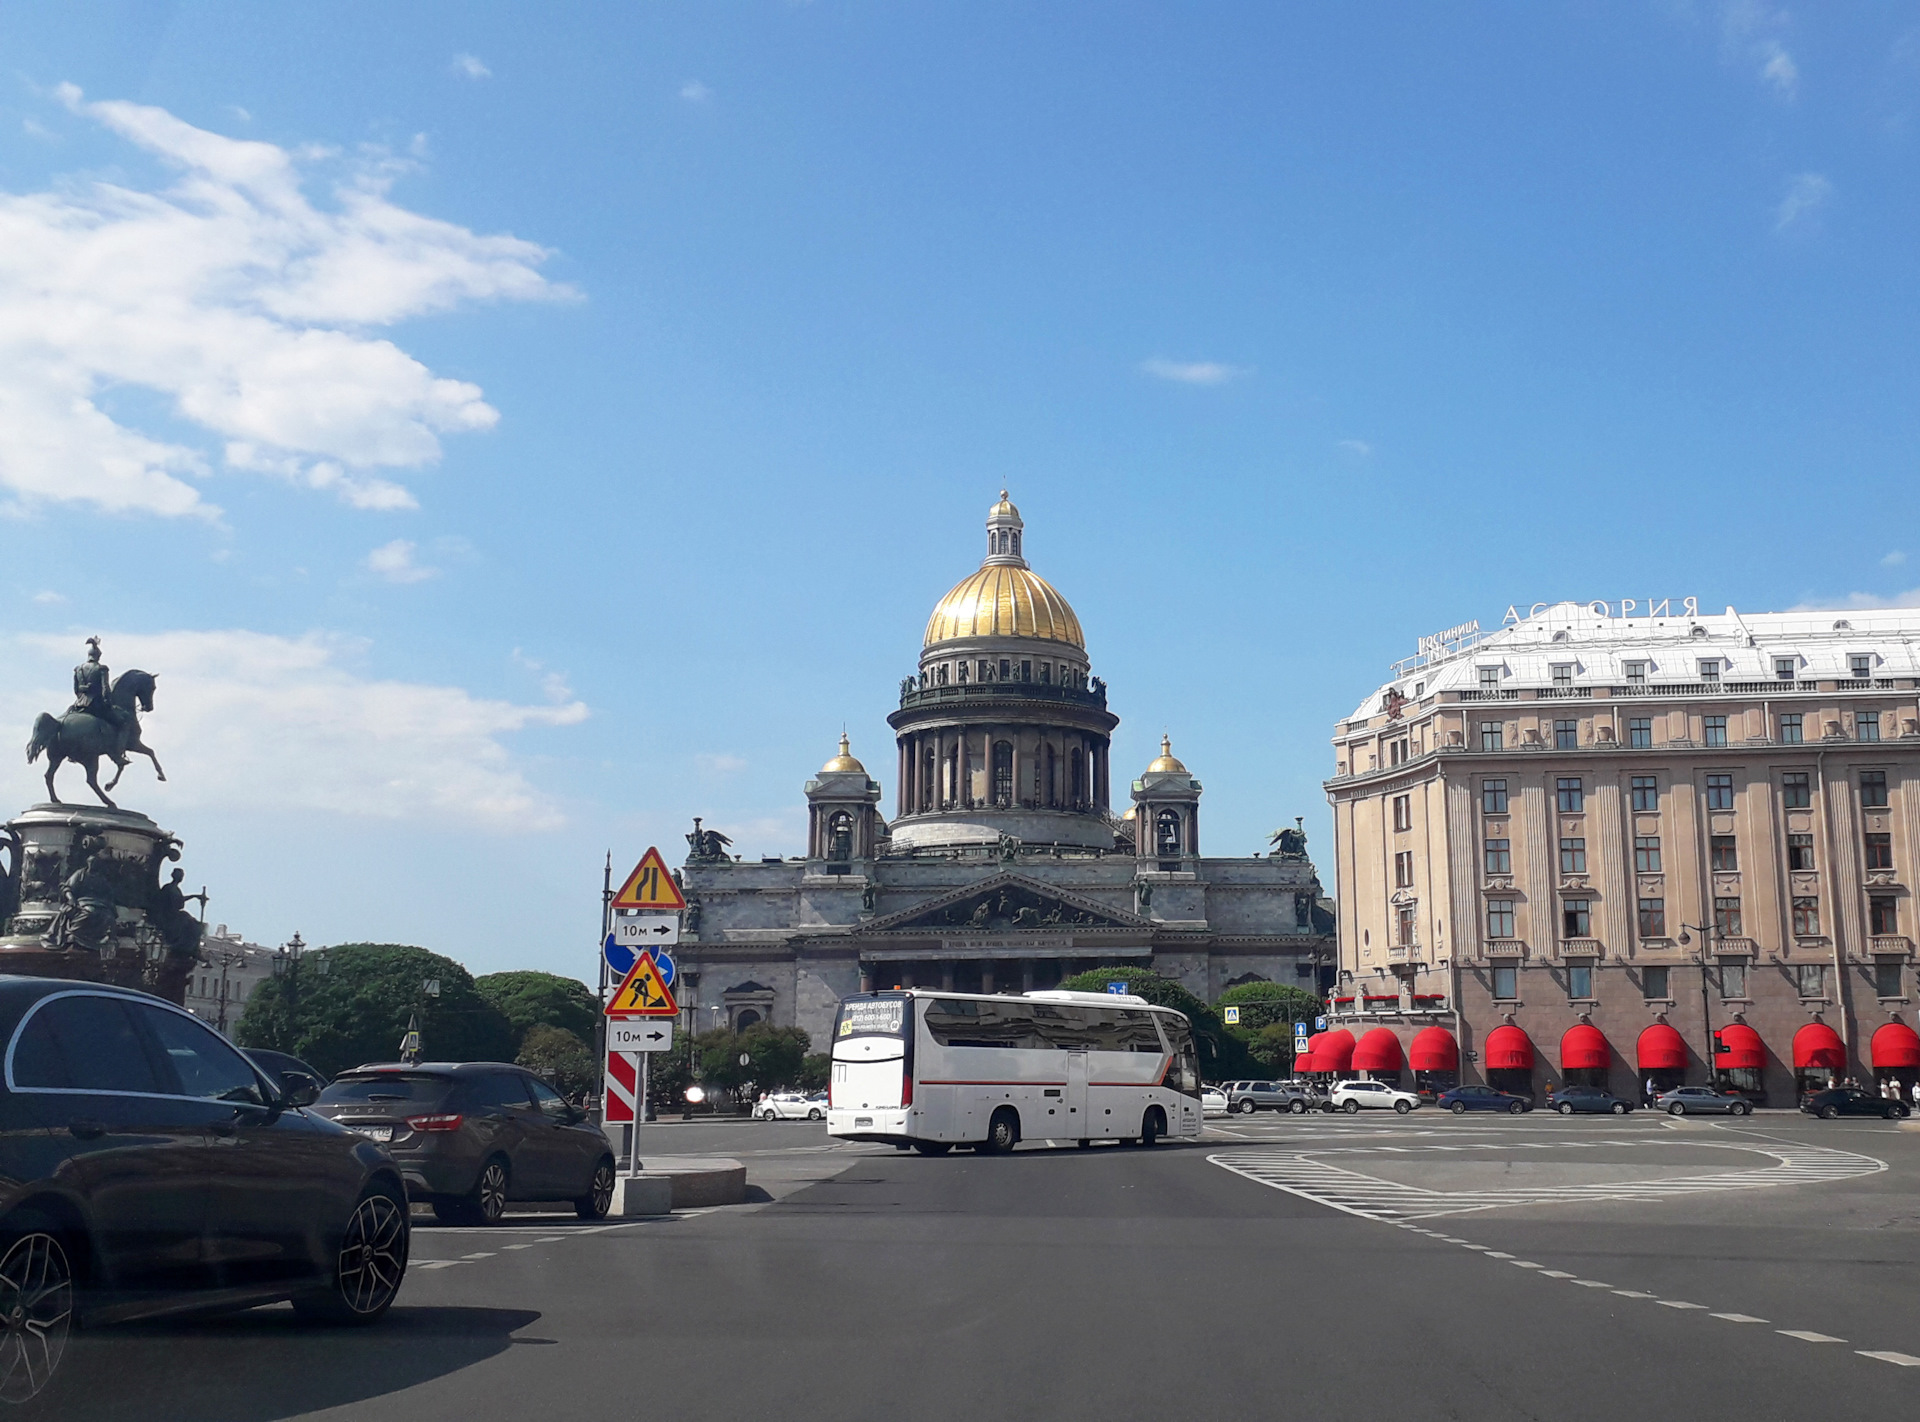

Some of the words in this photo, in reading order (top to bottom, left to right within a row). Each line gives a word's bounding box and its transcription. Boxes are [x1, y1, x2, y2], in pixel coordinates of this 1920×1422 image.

[1502, 596, 1698, 625] АСТОРИЯ
[1420, 619, 1479, 649] ГОСТИНИЦА
[845, 1002, 867, 1011] АРЕНДА
[868, 1001, 902, 1009] АВТОБУСОВ
